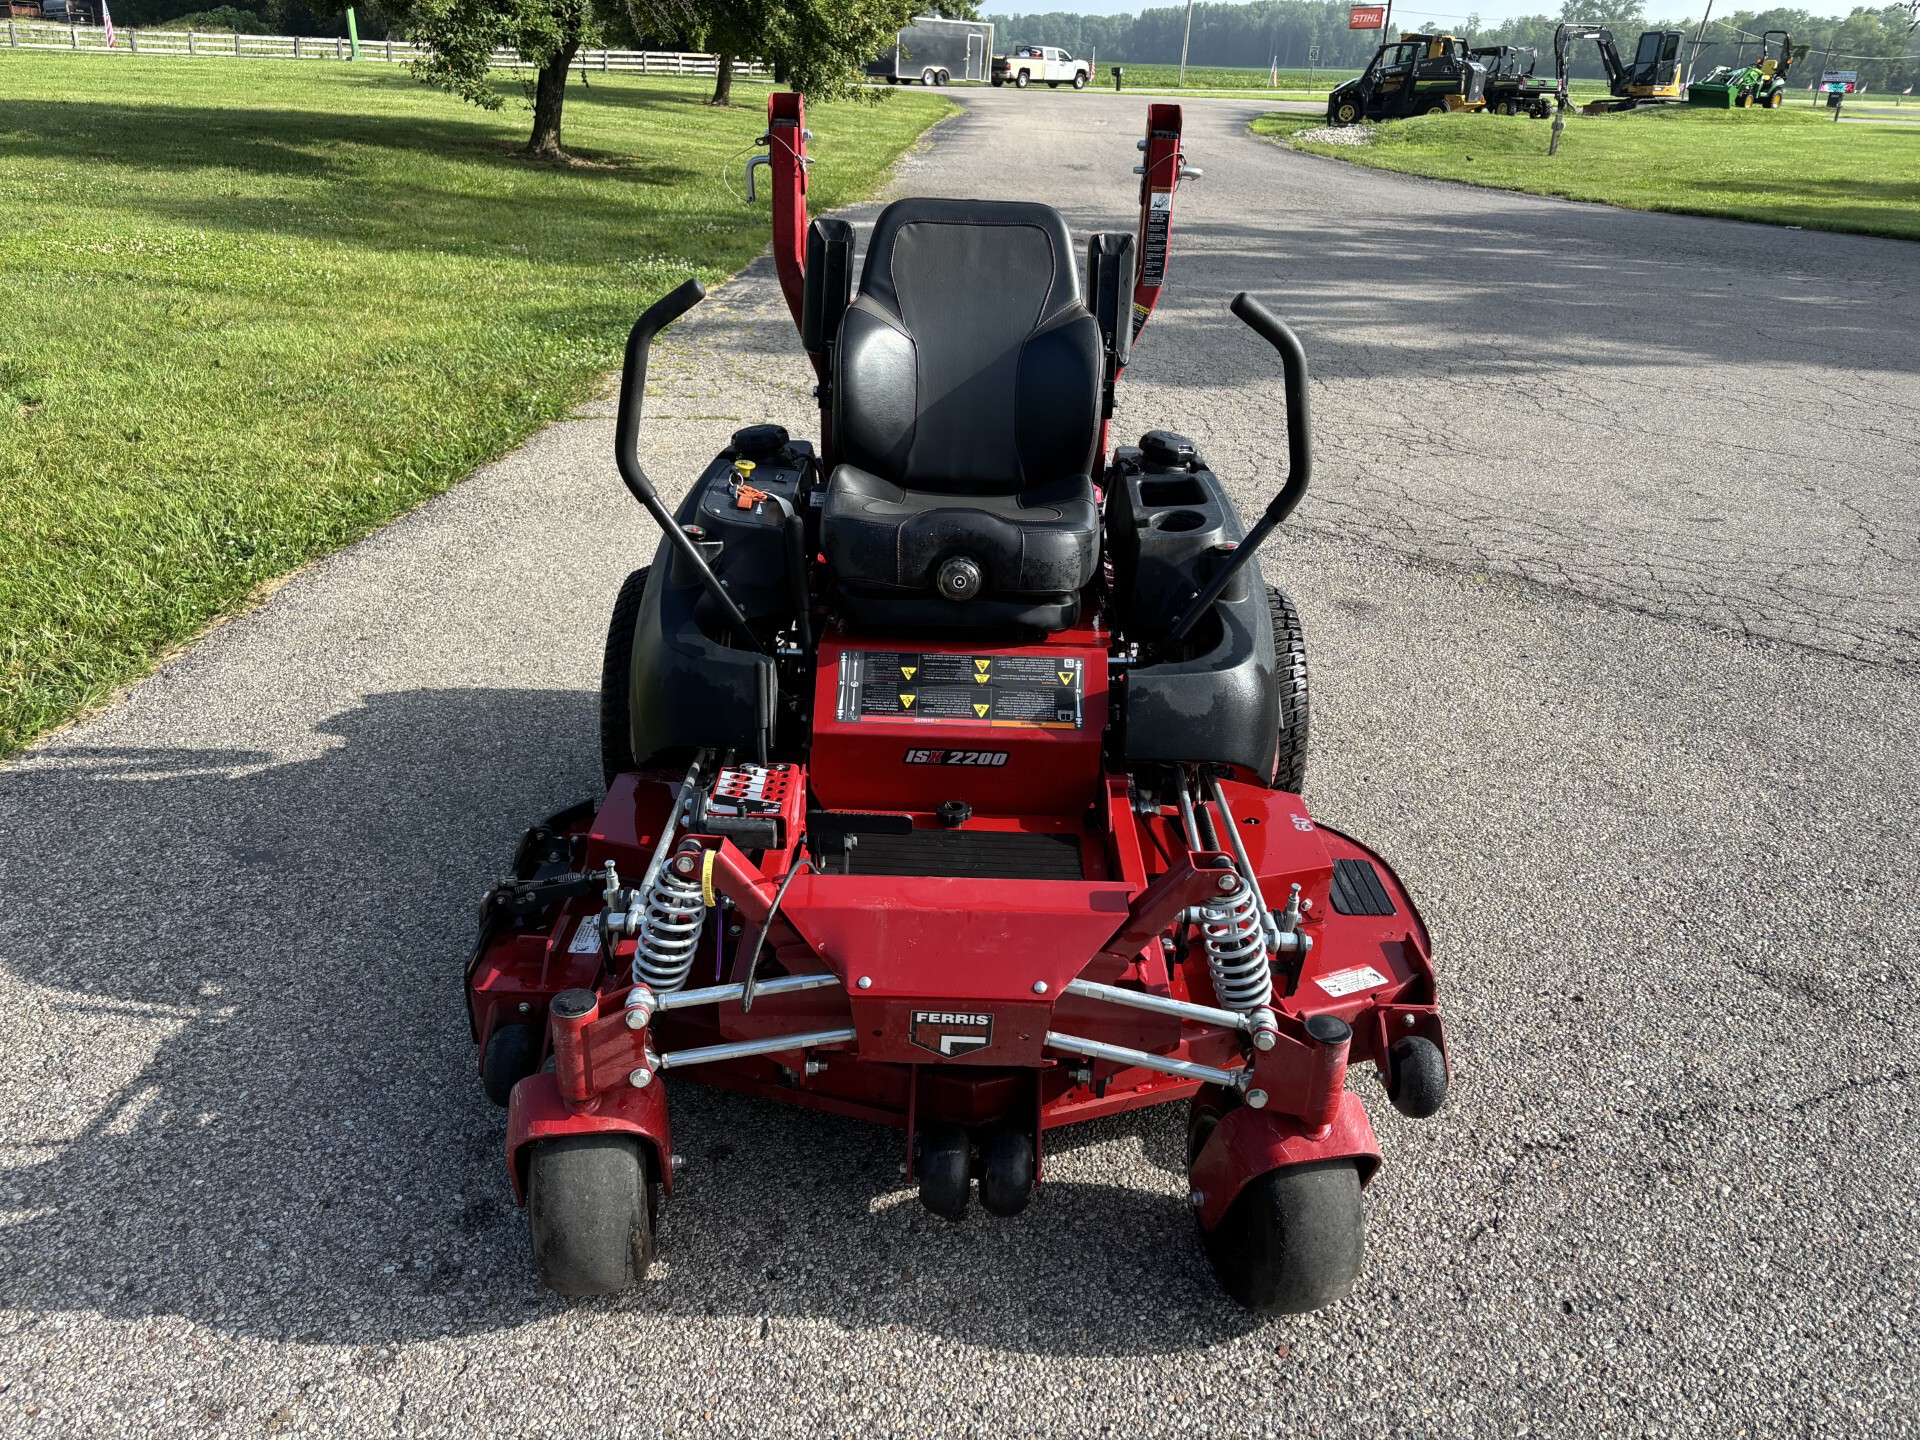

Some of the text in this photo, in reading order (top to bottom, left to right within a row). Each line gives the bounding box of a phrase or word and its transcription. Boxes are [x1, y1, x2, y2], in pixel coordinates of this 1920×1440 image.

[1351, 13, 1379, 23] STIHL
[905, 750, 1008, 766] ISX 2200
[916, 1012, 989, 1025] FERRIS
